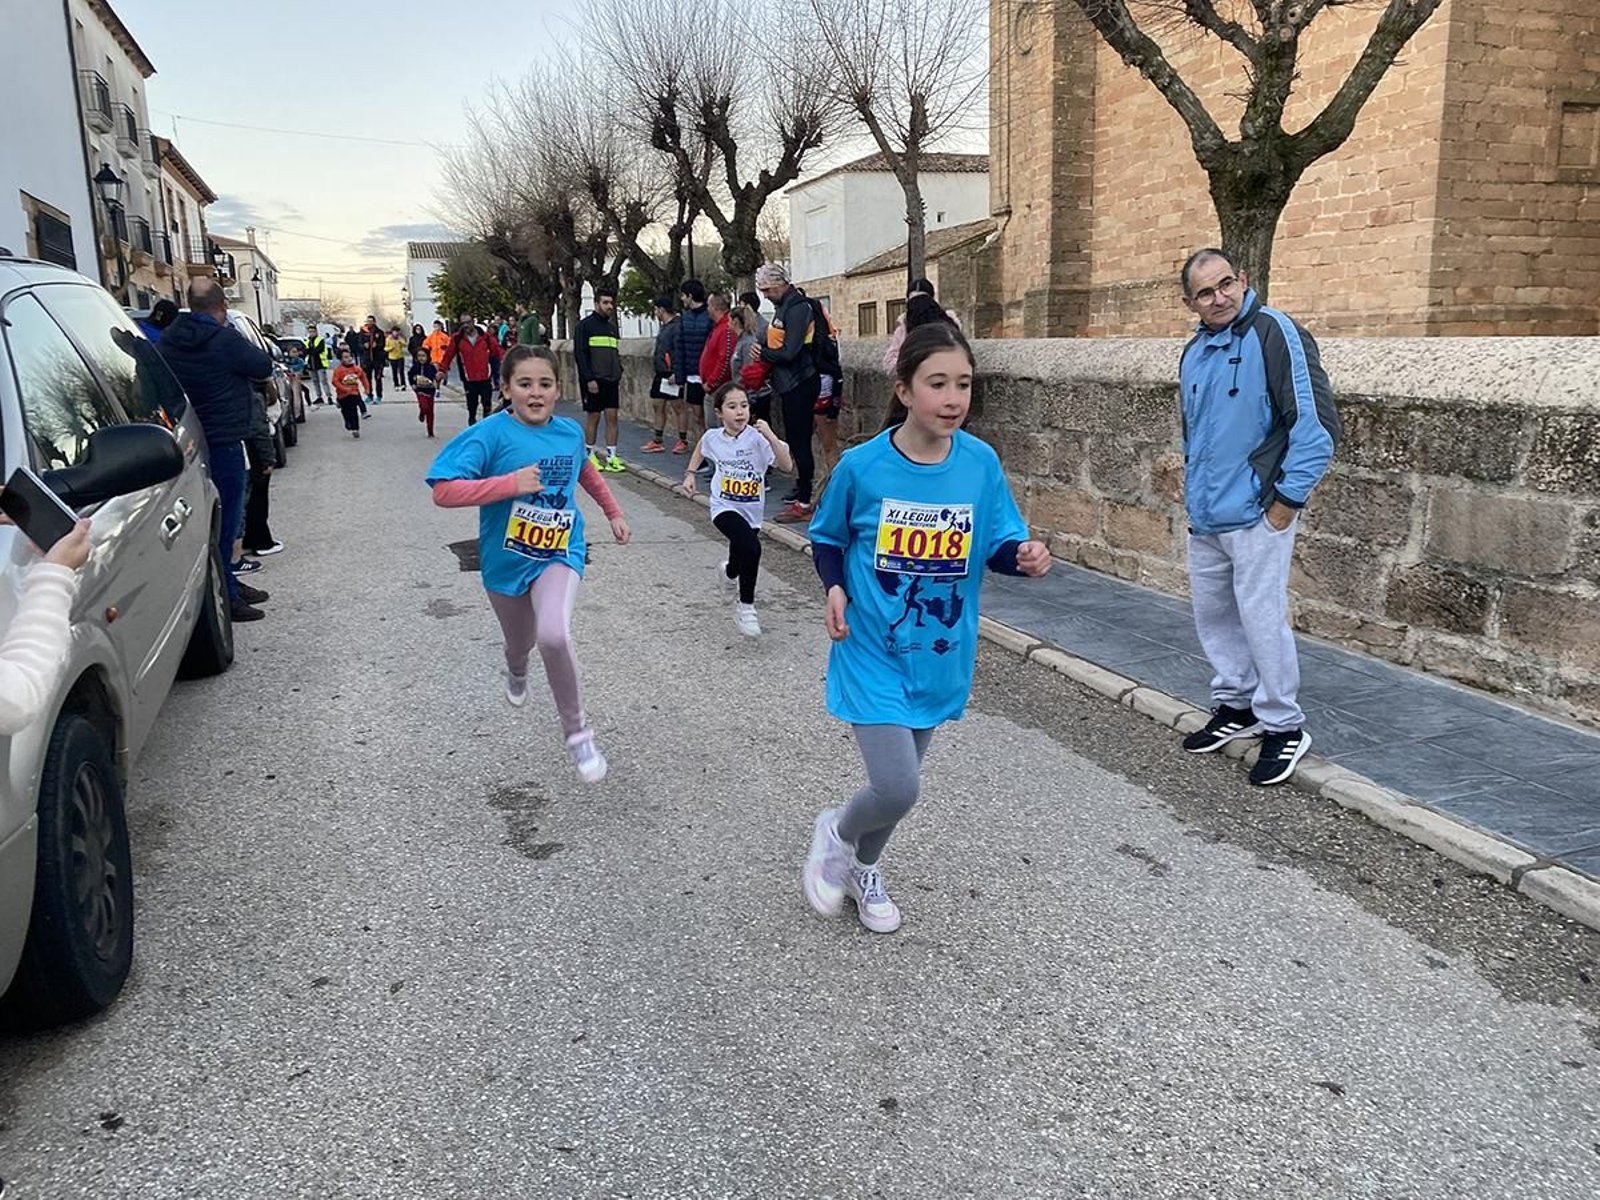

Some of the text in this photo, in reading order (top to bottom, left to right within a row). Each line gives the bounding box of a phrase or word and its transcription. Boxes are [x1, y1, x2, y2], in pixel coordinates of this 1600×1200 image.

[724, 479, 759, 496] 1038
[516, 507, 526, 515] XI
[527, 509, 553, 522] LEGUA
[887, 508, 901, 519] XI
[902, 511, 938, 523] LEGUA
[514, 521, 567, 549] 1097
[888, 527, 964, 559] 1018
